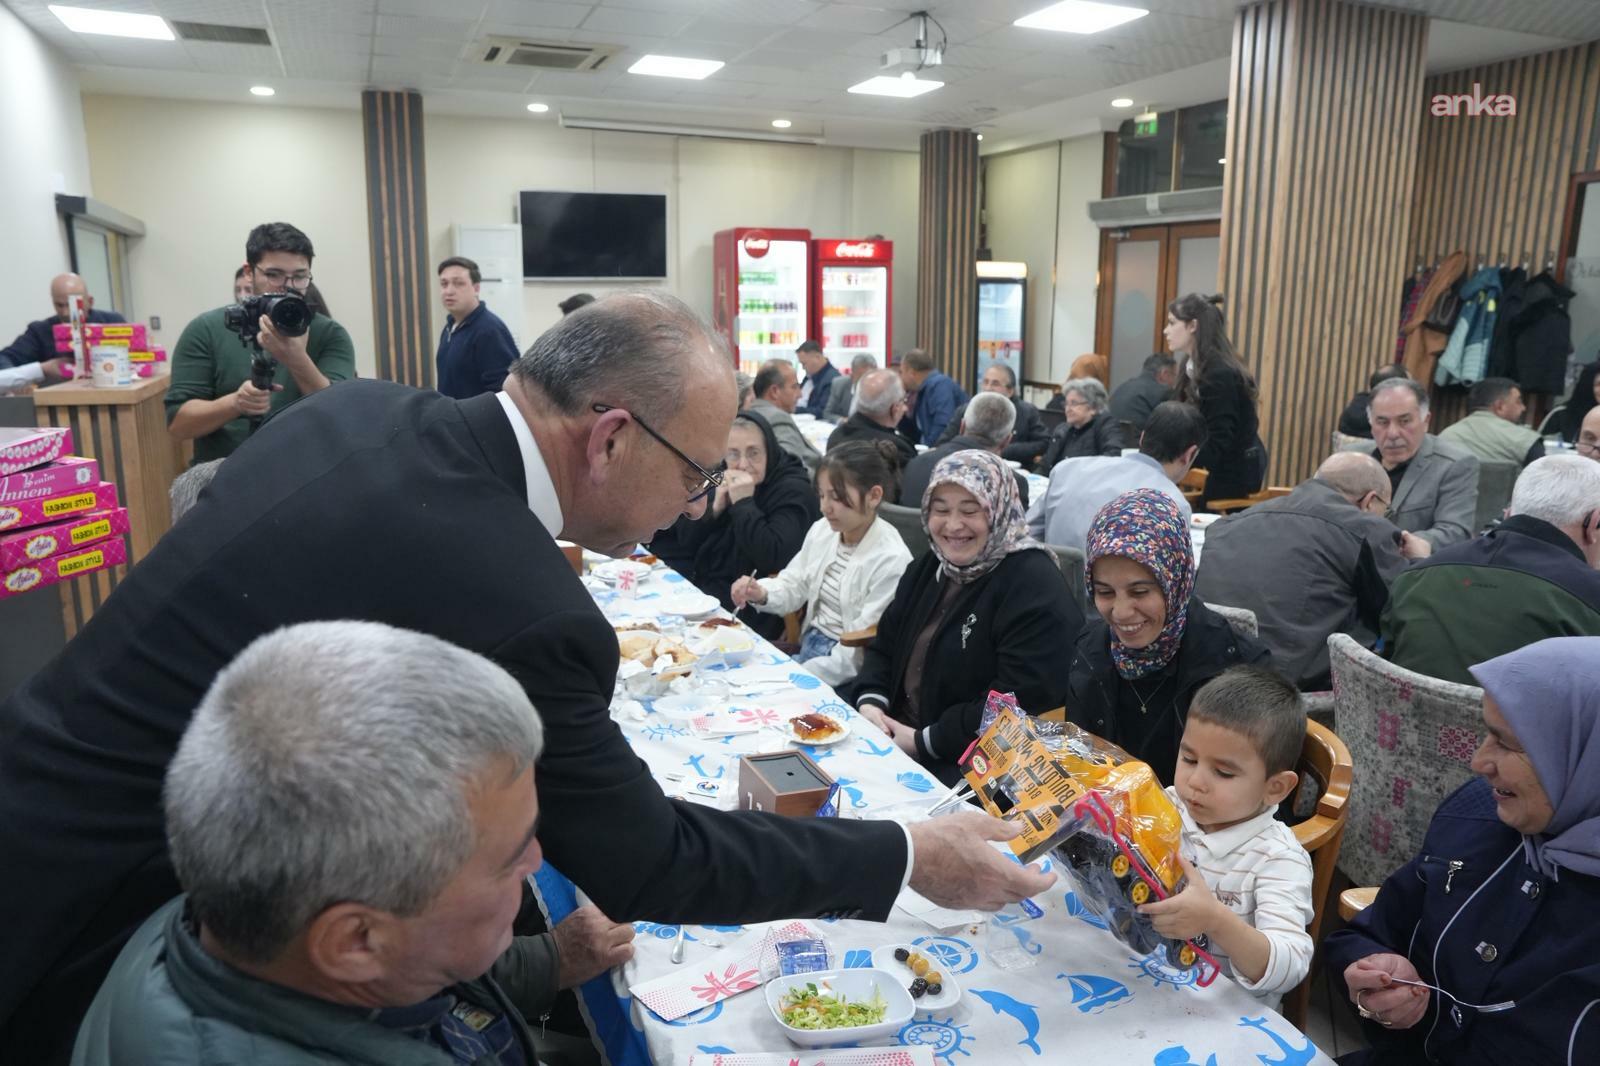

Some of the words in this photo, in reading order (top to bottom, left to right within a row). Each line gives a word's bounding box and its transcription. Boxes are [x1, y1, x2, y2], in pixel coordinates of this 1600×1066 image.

[45, 501, 73, 513] FASHION
[75, 497, 94, 509] STYLE
[72, 529, 94, 541] FASHION
[60, 560, 84, 572] FASHION
[85, 555, 102, 566] STYLE
[996, 715, 1034, 762] MACHINES
[1030, 755, 1076, 804] BUILDING
[1024, 782, 1042, 800] BIG
